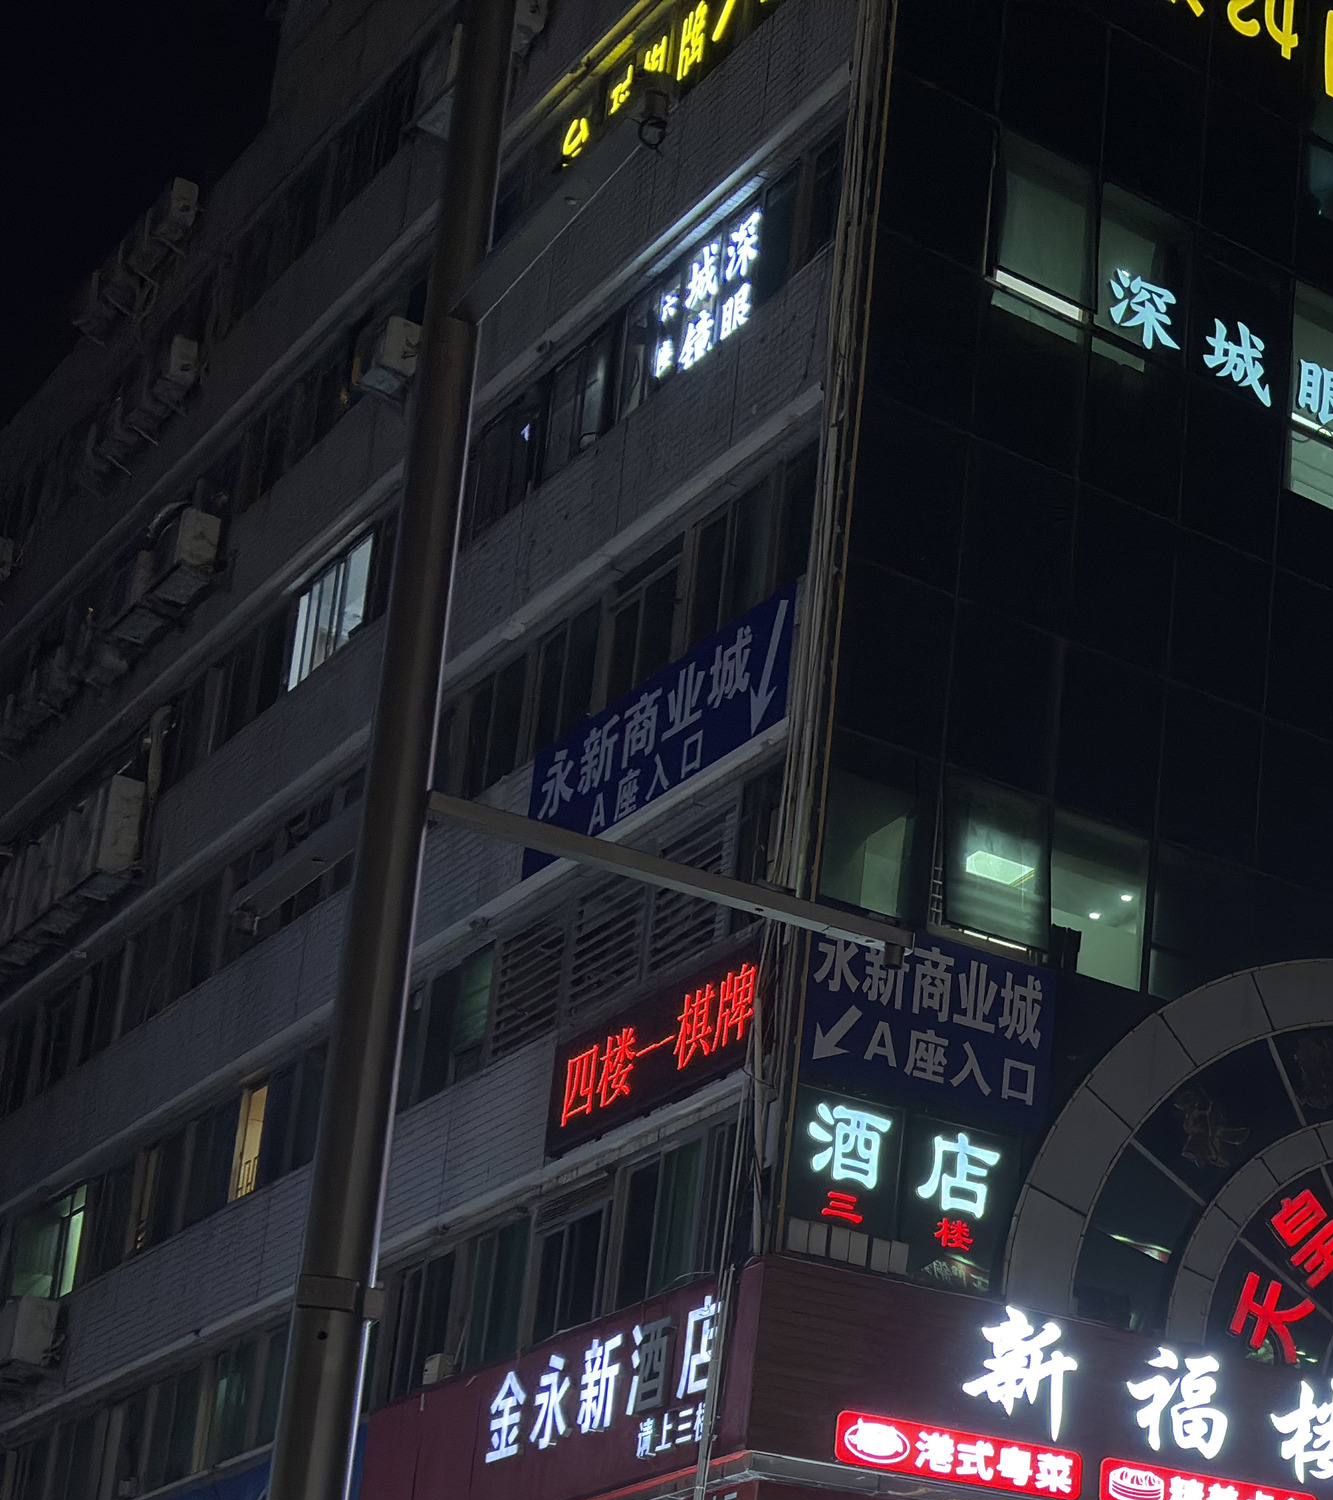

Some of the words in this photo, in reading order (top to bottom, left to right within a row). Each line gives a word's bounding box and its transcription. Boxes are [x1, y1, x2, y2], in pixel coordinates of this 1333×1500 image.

[537, 625, 755, 821] 永新商业城
[588, 729, 704, 835] A座入口
[814, 934, 1044, 1050] 永新商业城
[863, 1020, 1037, 1106] A座入口
[807, 1101, 1000, 1220] 酒店
[820, 1190, 974, 1252] 三楼
[485, 1295, 721, 1463] 金永新酒店
[914, 1431, 1073, 1496] 港式粤菜
